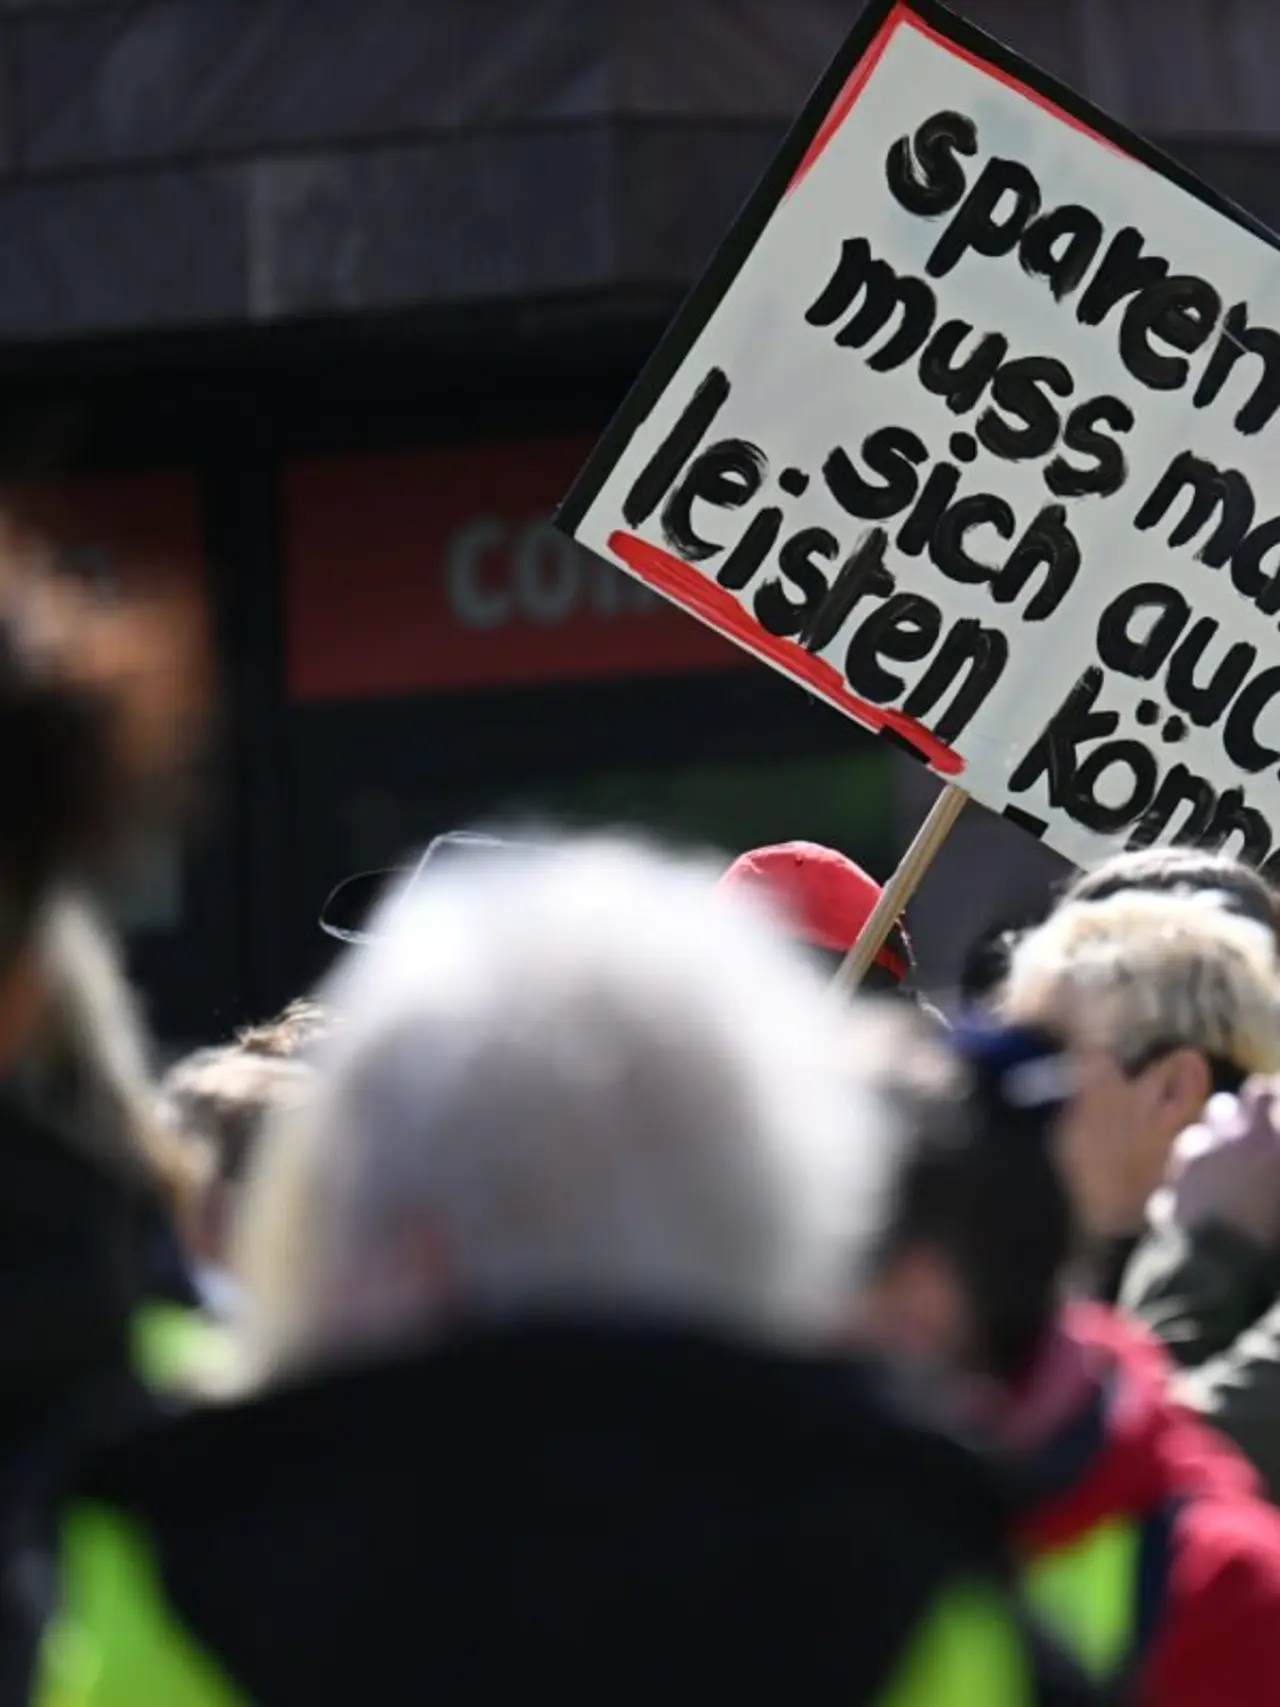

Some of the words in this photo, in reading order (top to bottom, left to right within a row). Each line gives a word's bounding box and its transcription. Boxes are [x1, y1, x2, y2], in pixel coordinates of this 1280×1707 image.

[805, 237, 1135, 499] muss
[622, 366, 1008, 746] leisten
[822, 426, 1081, 621] sich
